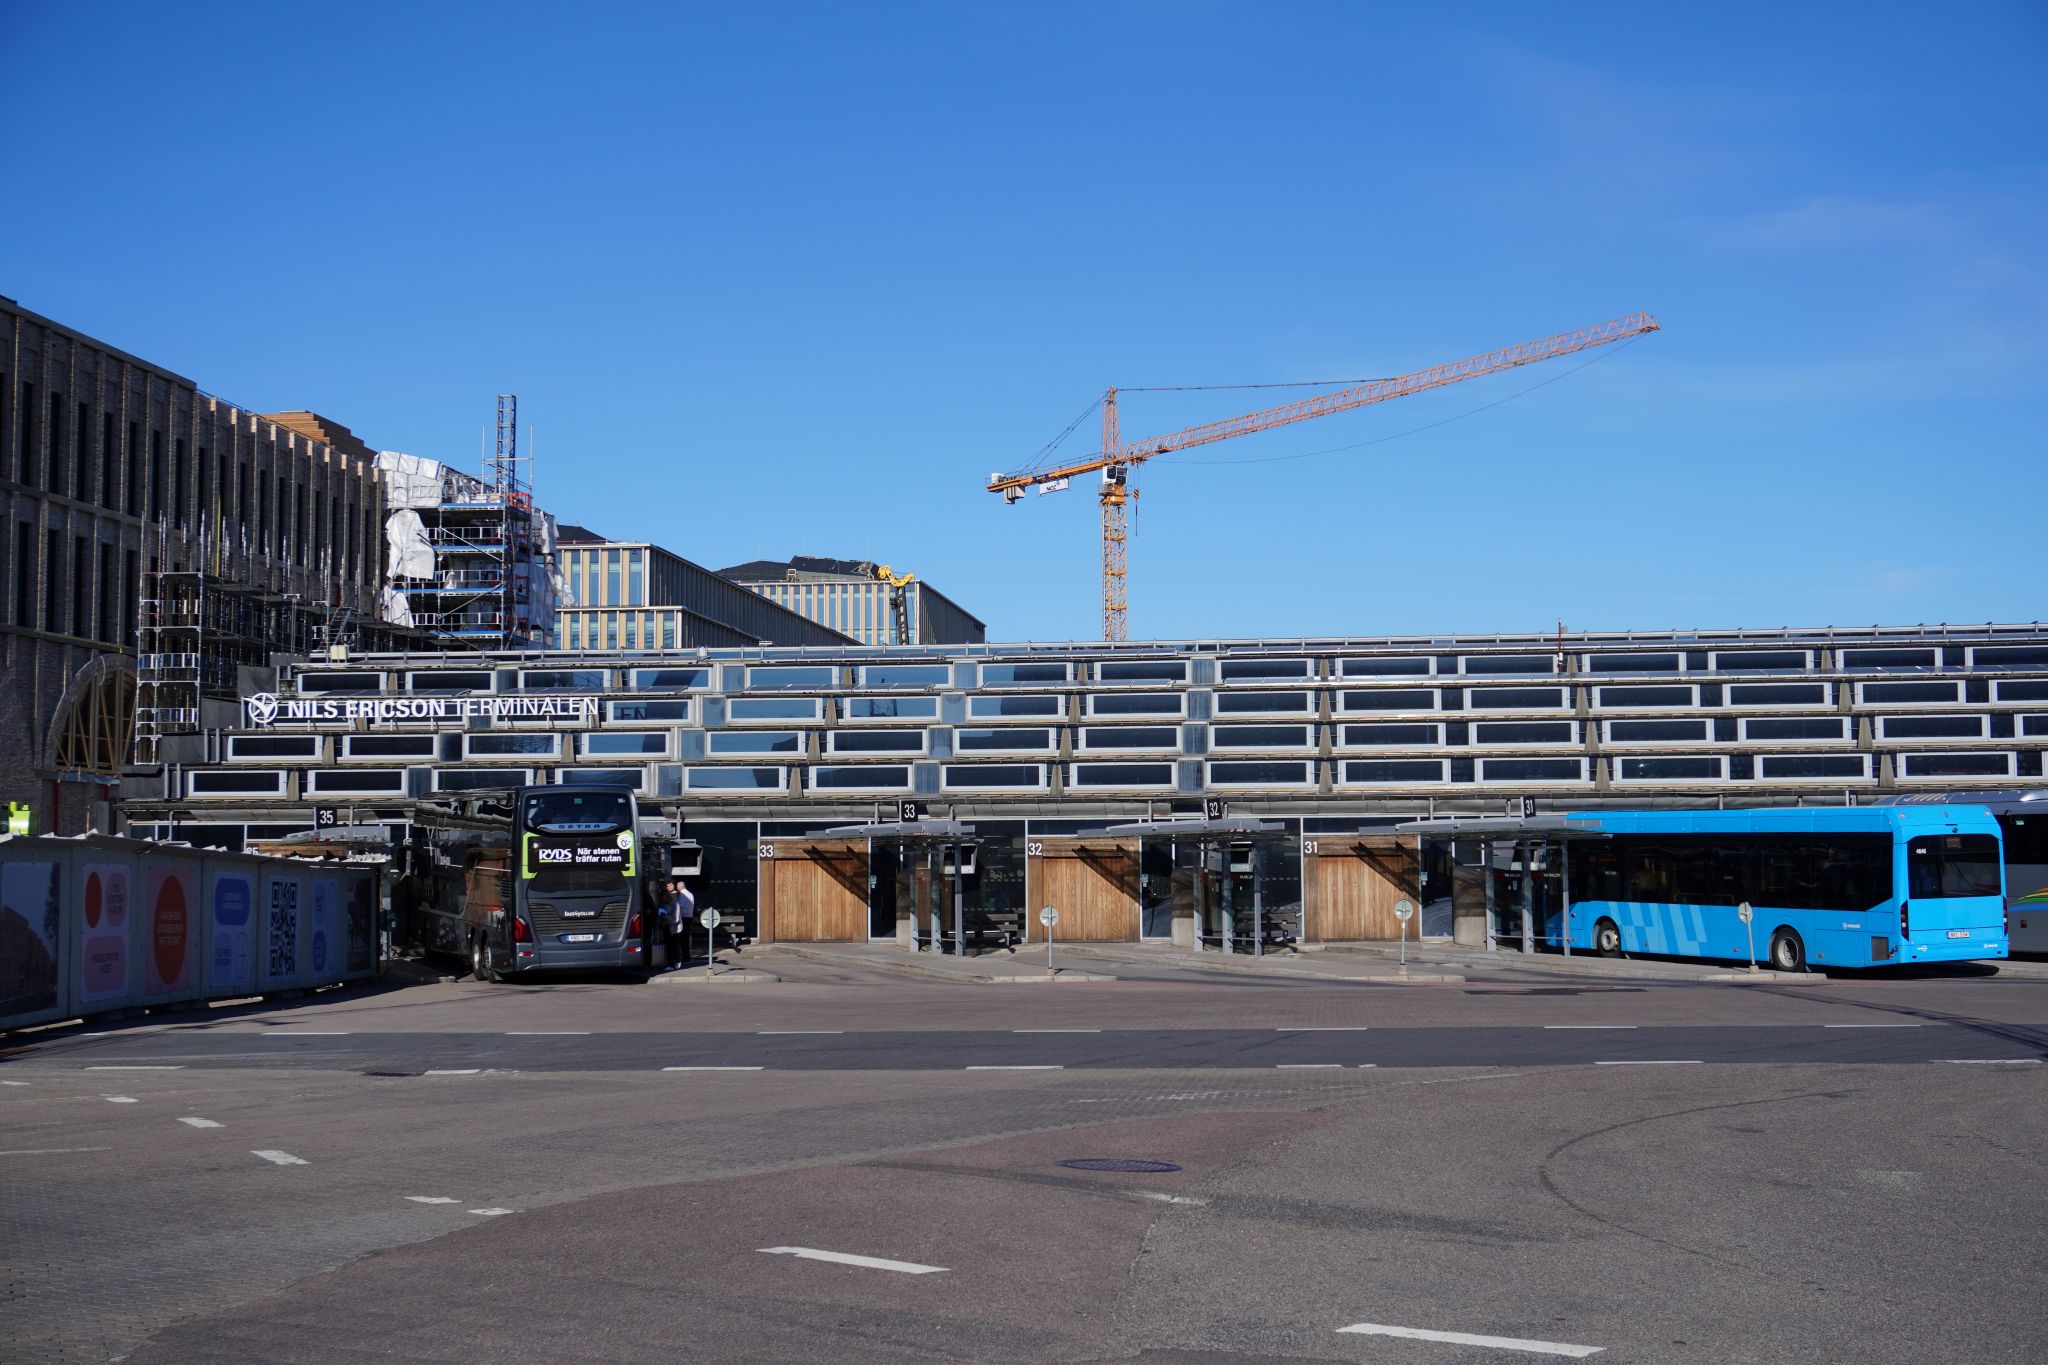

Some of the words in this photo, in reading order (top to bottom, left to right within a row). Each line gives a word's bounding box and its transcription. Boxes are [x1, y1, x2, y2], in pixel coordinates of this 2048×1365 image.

[288, 699, 338, 719] NILS
[345, 698, 445, 718] ERICSON
[452, 697, 599, 717] TERMINALEN
[904, 804, 915, 818] 33
[1209, 801, 1219, 817] 32
[1525, 798, 1534, 815] 31
[319, 810, 333, 824] 35
[539, 848, 572, 860] RYDS
[577, 847, 592, 855] När
[593, 847, 620, 855] stenen
[759, 845, 774, 858] 33
[1028, 843, 1043, 856] 32
[1304, 841, 1318, 854] 31
[575, 855, 600, 863] träffar
[601, 854, 622, 862] rutan
